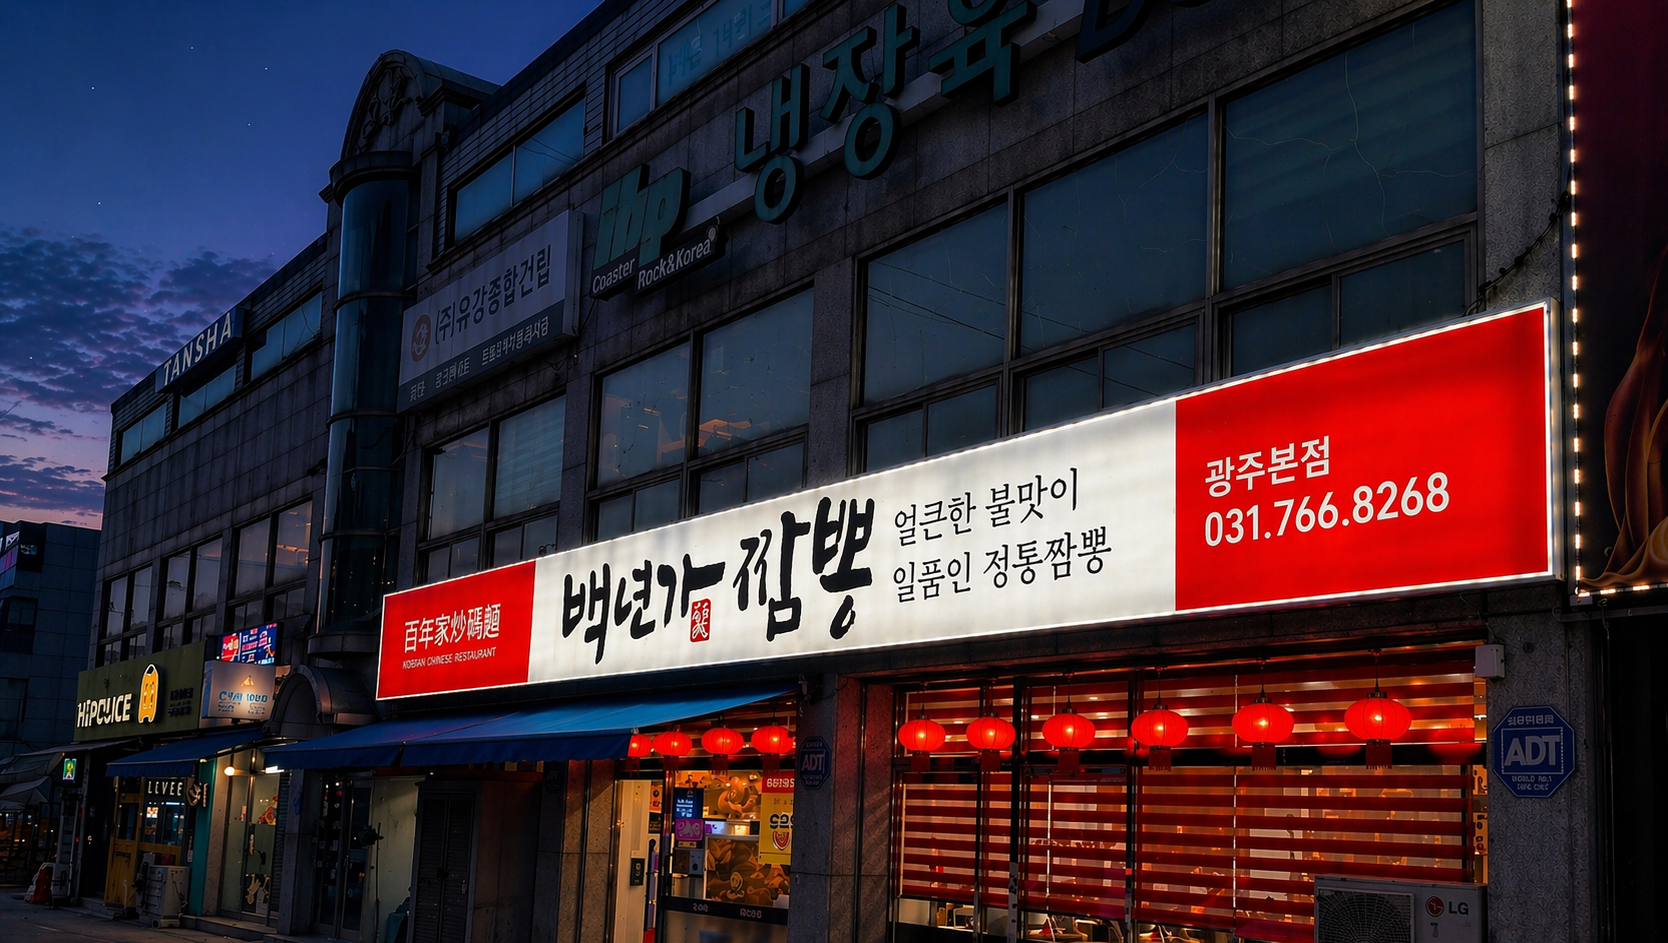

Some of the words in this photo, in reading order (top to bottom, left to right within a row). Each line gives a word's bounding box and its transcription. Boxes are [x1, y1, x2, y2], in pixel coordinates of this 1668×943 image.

[592, 257, 635, 294] Coaster
[637, 238, 711, 290] Rock&Korea
[164, 312, 231, 386] TANSHA
[1204, 435, 1330, 498] 광주본점
[894, 491, 977, 547] 얼큰한
[985, 467, 1078, 528] 불맛이
[1204, 471, 1450, 547] 031.766.8268
[562, 553, 726, 665] 백년가
[732, 496, 875, 642] 짬뽕
[893, 551, 971, 603] 일품인
[983, 526, 1112, 588] 정통짬뽕
[801, 753, 825, 771] ADT
[1503, 734, 1561, 766] ADT
[1448, 901, 1469, 916] LG
